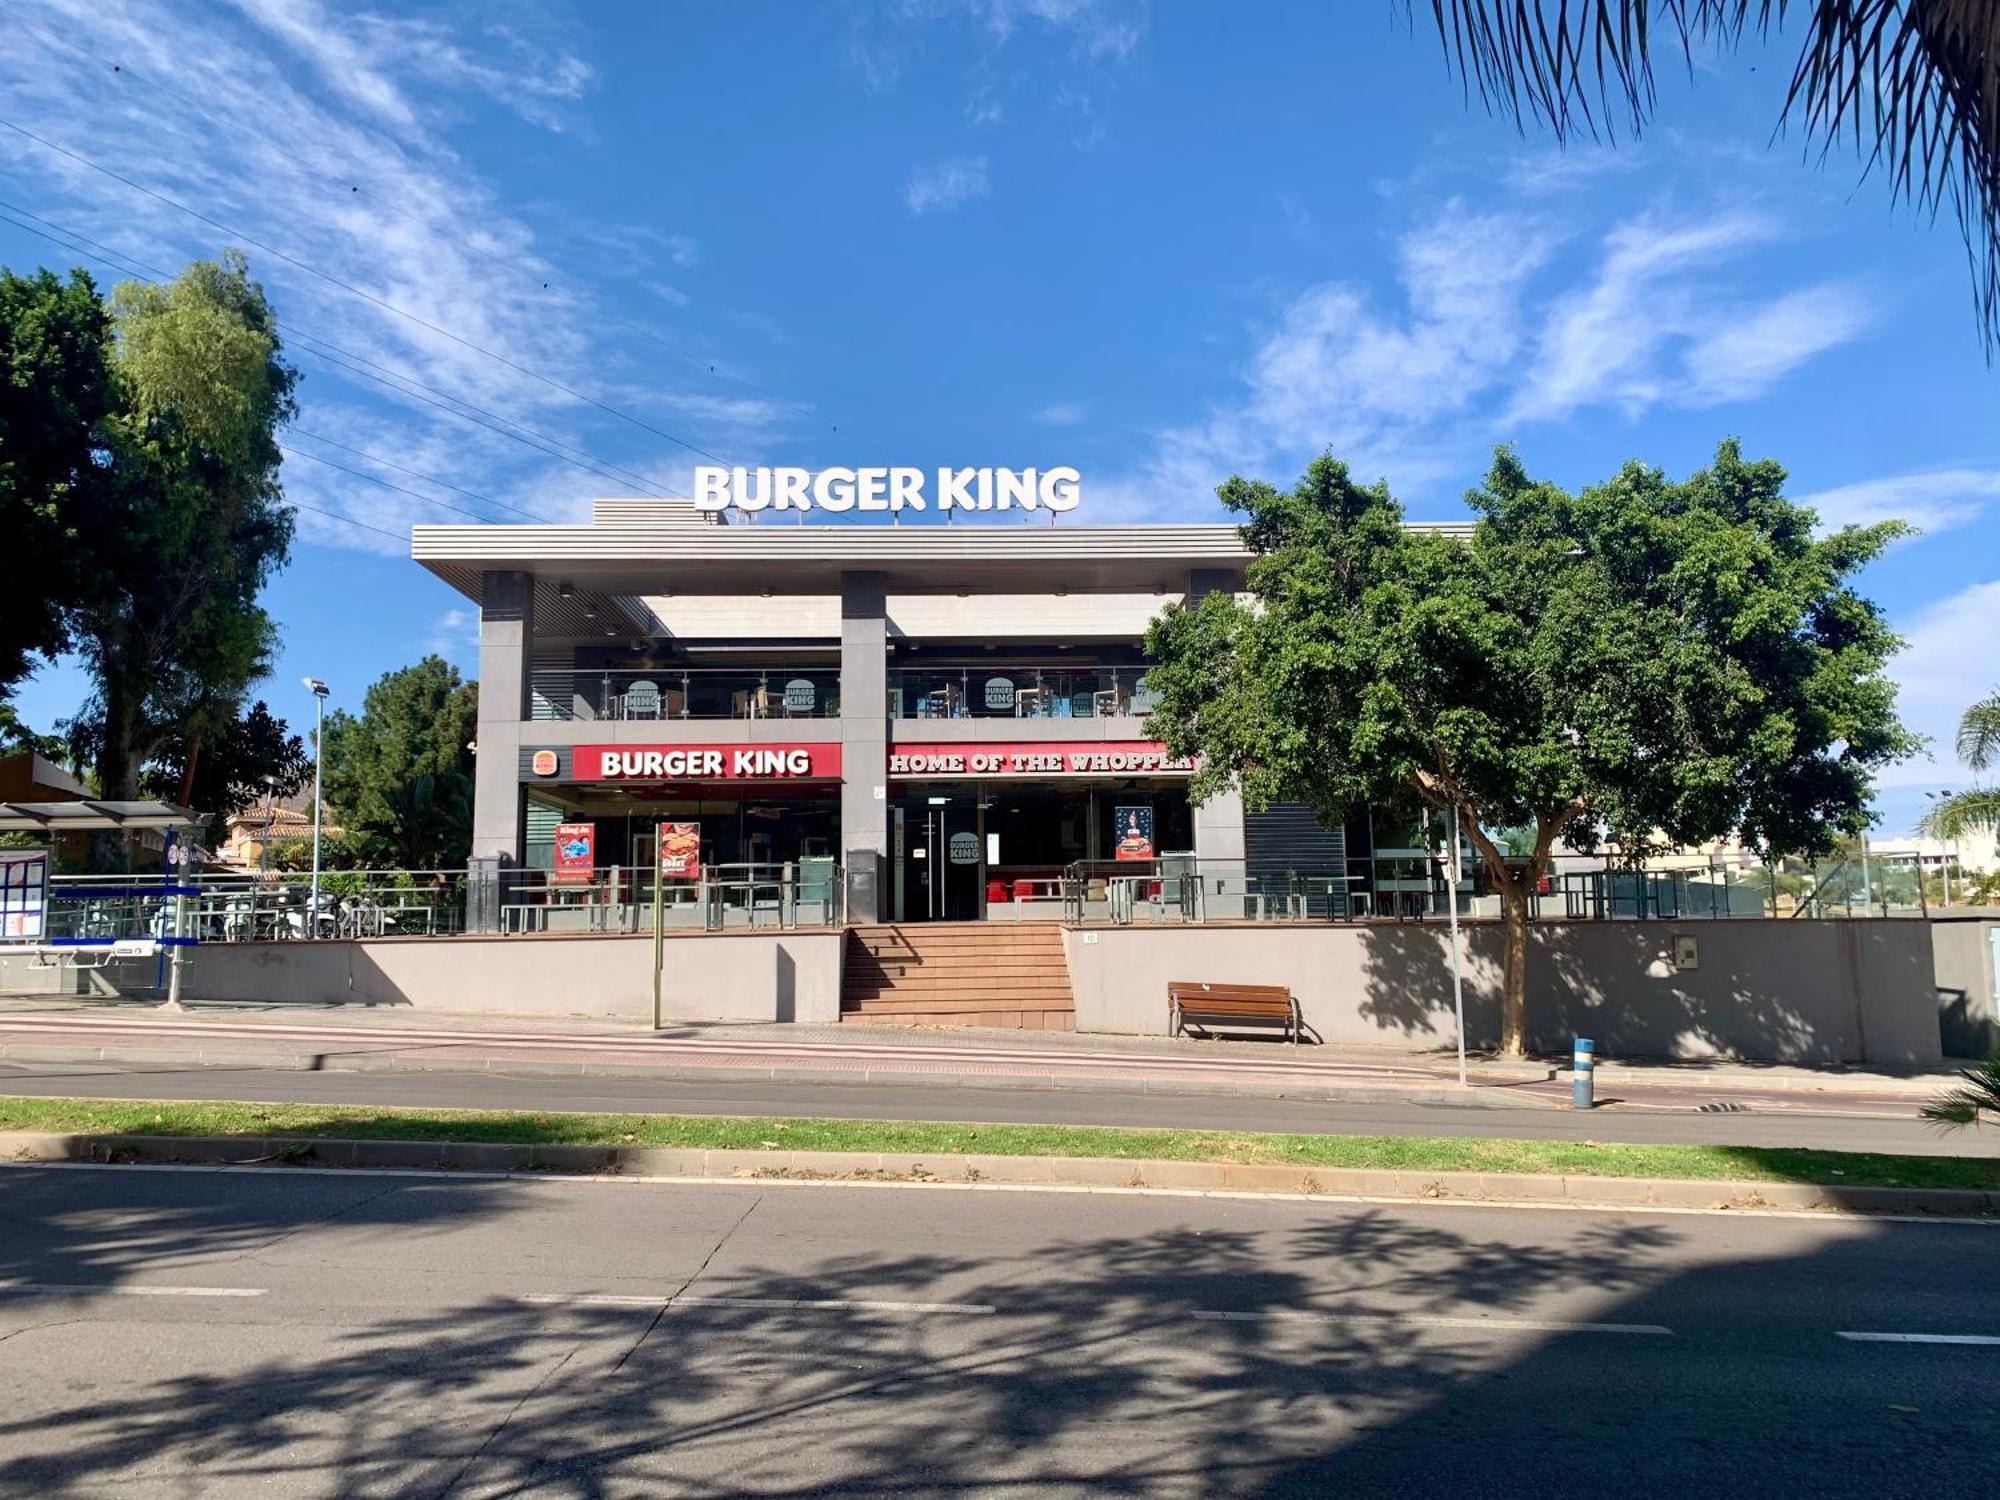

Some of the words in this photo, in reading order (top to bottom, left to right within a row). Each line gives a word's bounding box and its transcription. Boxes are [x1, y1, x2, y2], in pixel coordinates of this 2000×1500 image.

[694, 466, 925, 512] BURGER
[938, 466, 1081, 512] KING
[985, 694, 1014, 704] KING
[601, 751, 722, 776] BURGER
[734, 750, 809, 774] KING
[890, 754, 963, 772] HOME
[971, 754, 1004, 771] OF
[1011, 754, 1064, 771] THE
[950, 848, 979, 858] KING
